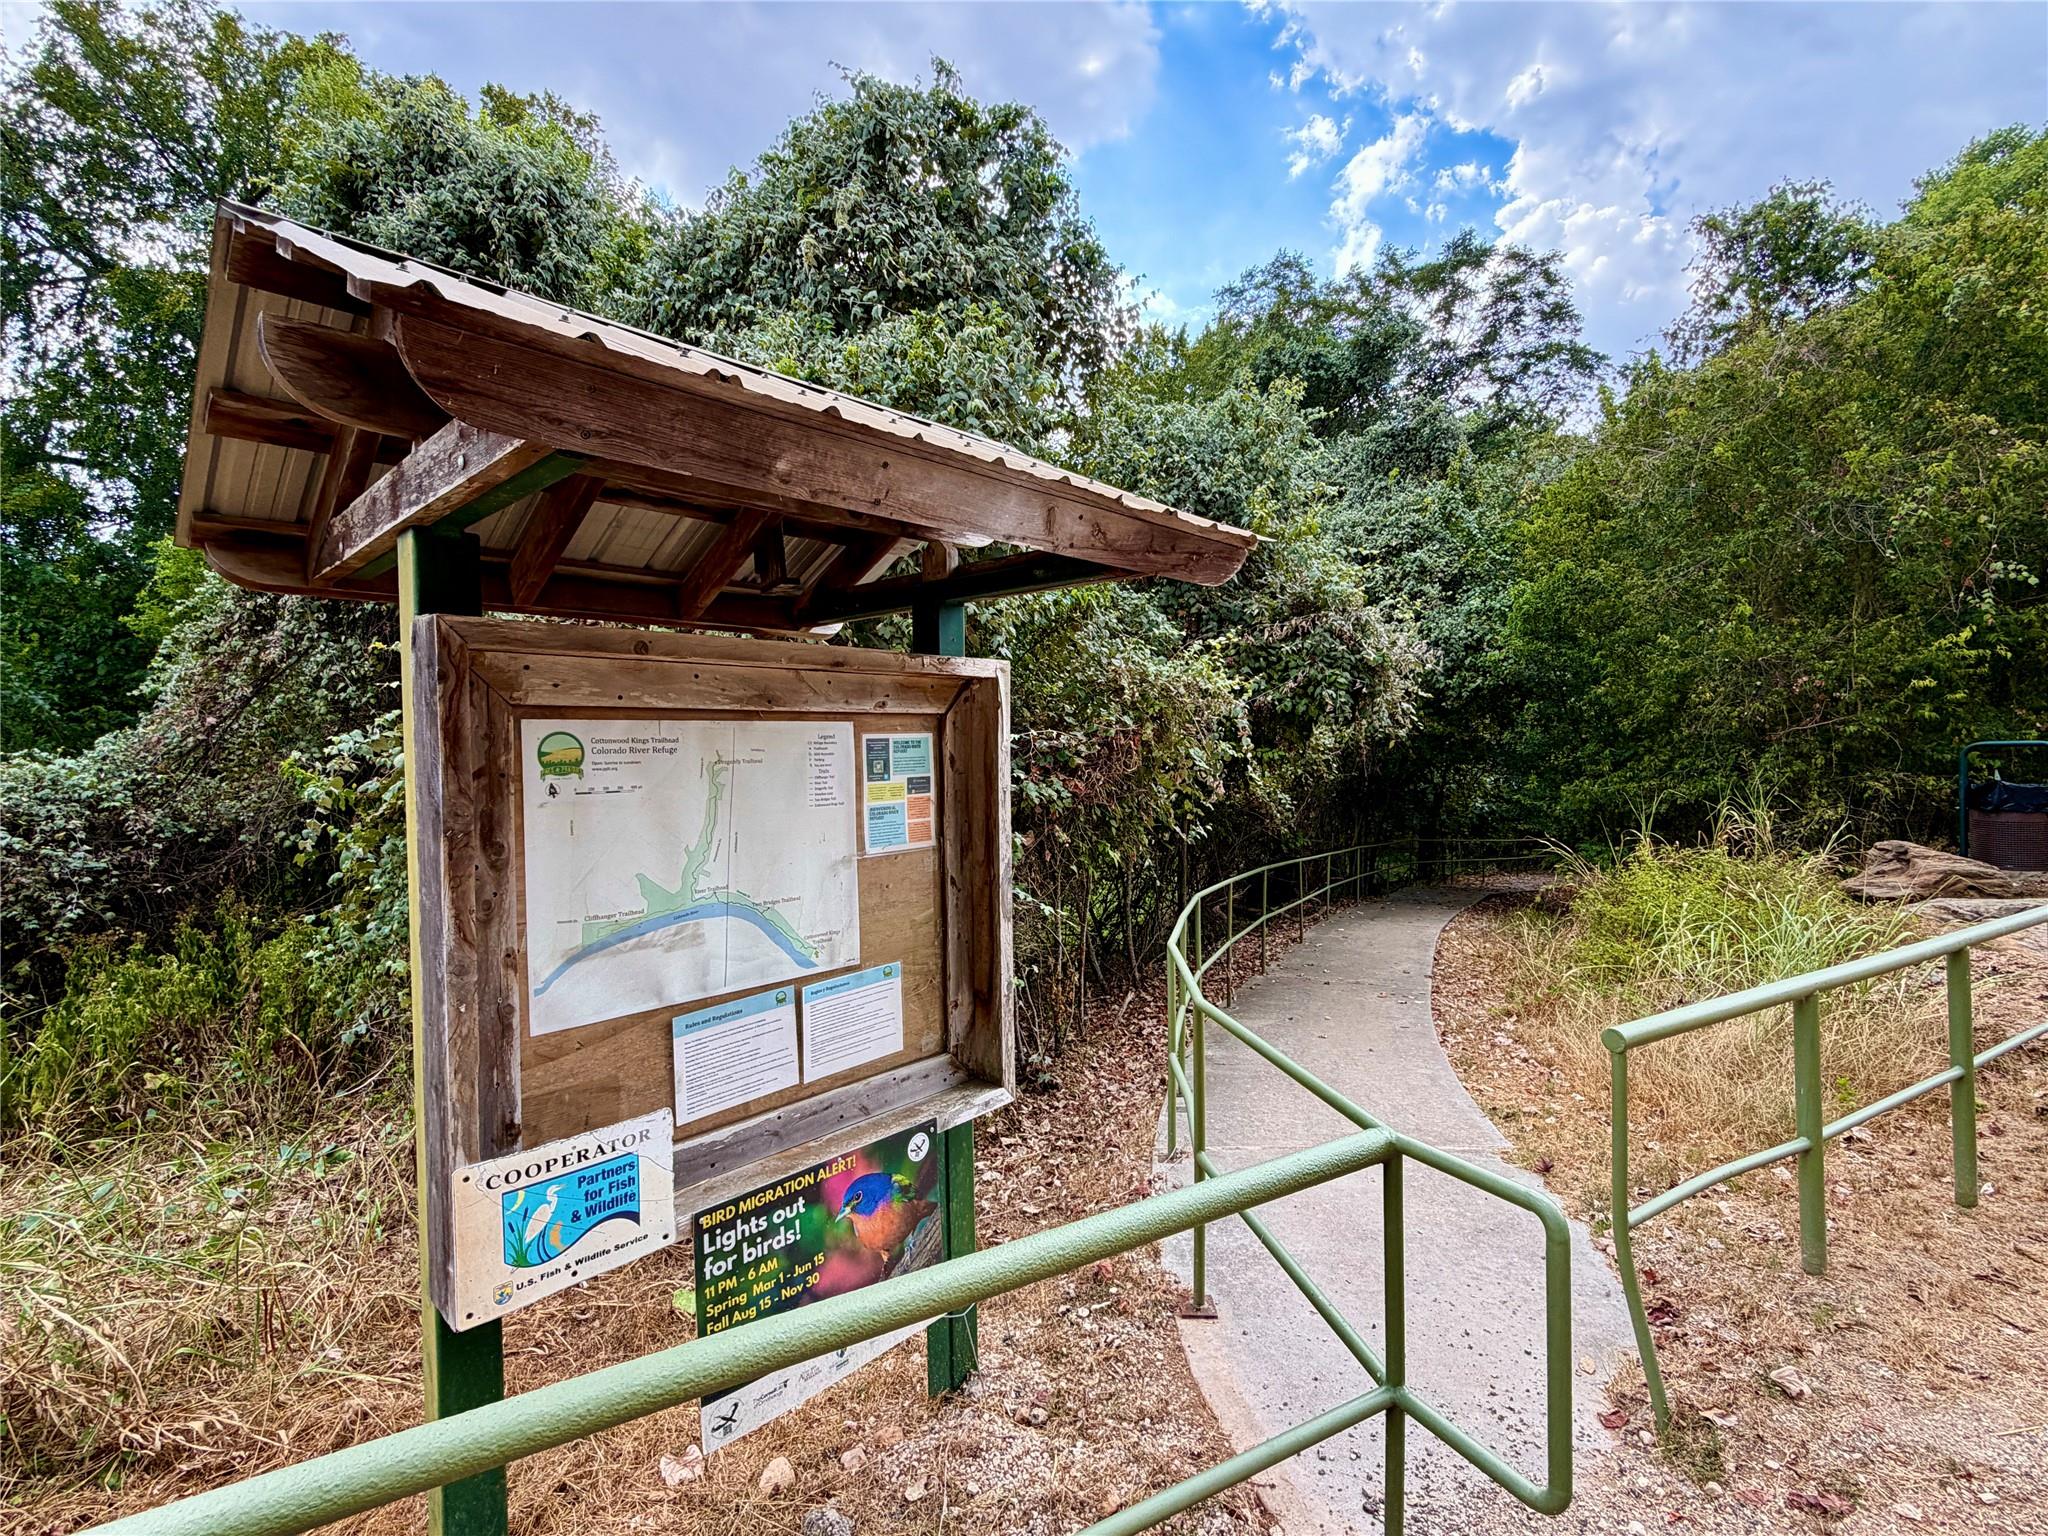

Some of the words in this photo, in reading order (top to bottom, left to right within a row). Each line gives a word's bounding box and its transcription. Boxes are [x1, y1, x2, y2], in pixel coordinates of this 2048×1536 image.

[590, 737, 630, 745] Cottonwood
[631, 737, 650, 745] Kings
[591, 746, 627, 755] Colorado
[628, 746, 650, 754] River
[652, 746, 678, 755] Refuge
[584, 912, 617, 921] Cliffhanger
[618, 908, 645, 917] Trailhead
[685, 1020, 700, 1029] Rules
[701, 1016, 711, 1025] and
[712, 1009, 743, 1022] Regulations
[486, 1127, 651, 1191] COOPERATOR
[577, 1161, 636, 1189] Partners
[571, 1210, 582, 1223] &
[584, 1191, 636, 1218] Wildlife
[584, 1187, 604, 1202] for
[608, 1175, 636, 1194] Fish
[702, 1205, 736, 1230] BIRD
[738, 1172, 815, 1215] MIGRATION
[816, 1154, 857, 1183] ALERT!
[703, 1215, 768, 1255] Lights
[772, 1196, 806, 1224] out
[516, 1279, 538, 1291] U.S.
[540, 1266, 561, 1281] Fish
[564, 1262, 572, 1271] &
[574, 1248, 611, 1266] Wildlife
[613, 1233, 649, 1252] Service
[703, 1254, 738, 1280] for
[742, 1219, 802, 1264] birds!
[704, 1285, 715, 1299] 11
[717, 1275, 738, 1294] PM
[747, 1267, 756, 1280] 6
[758, 1257, 778, 1276] AM
[706, 1291, 748, 1317] Spring
[752, 1278, 777, 1296] Mar
[778, 1271, 784, 1284] 1
[793, 1261, 812, 1277] Jun
[813, 1252, 825, 1266] 15
[706, 1314, 729, 1335] Fall
[731, 1305, 757, 1324] Aug
[759, 1295, 772, 1310] 15
[781, 1282, 804, 1301] Nov
[805, 1271, 821, 1288] 30
